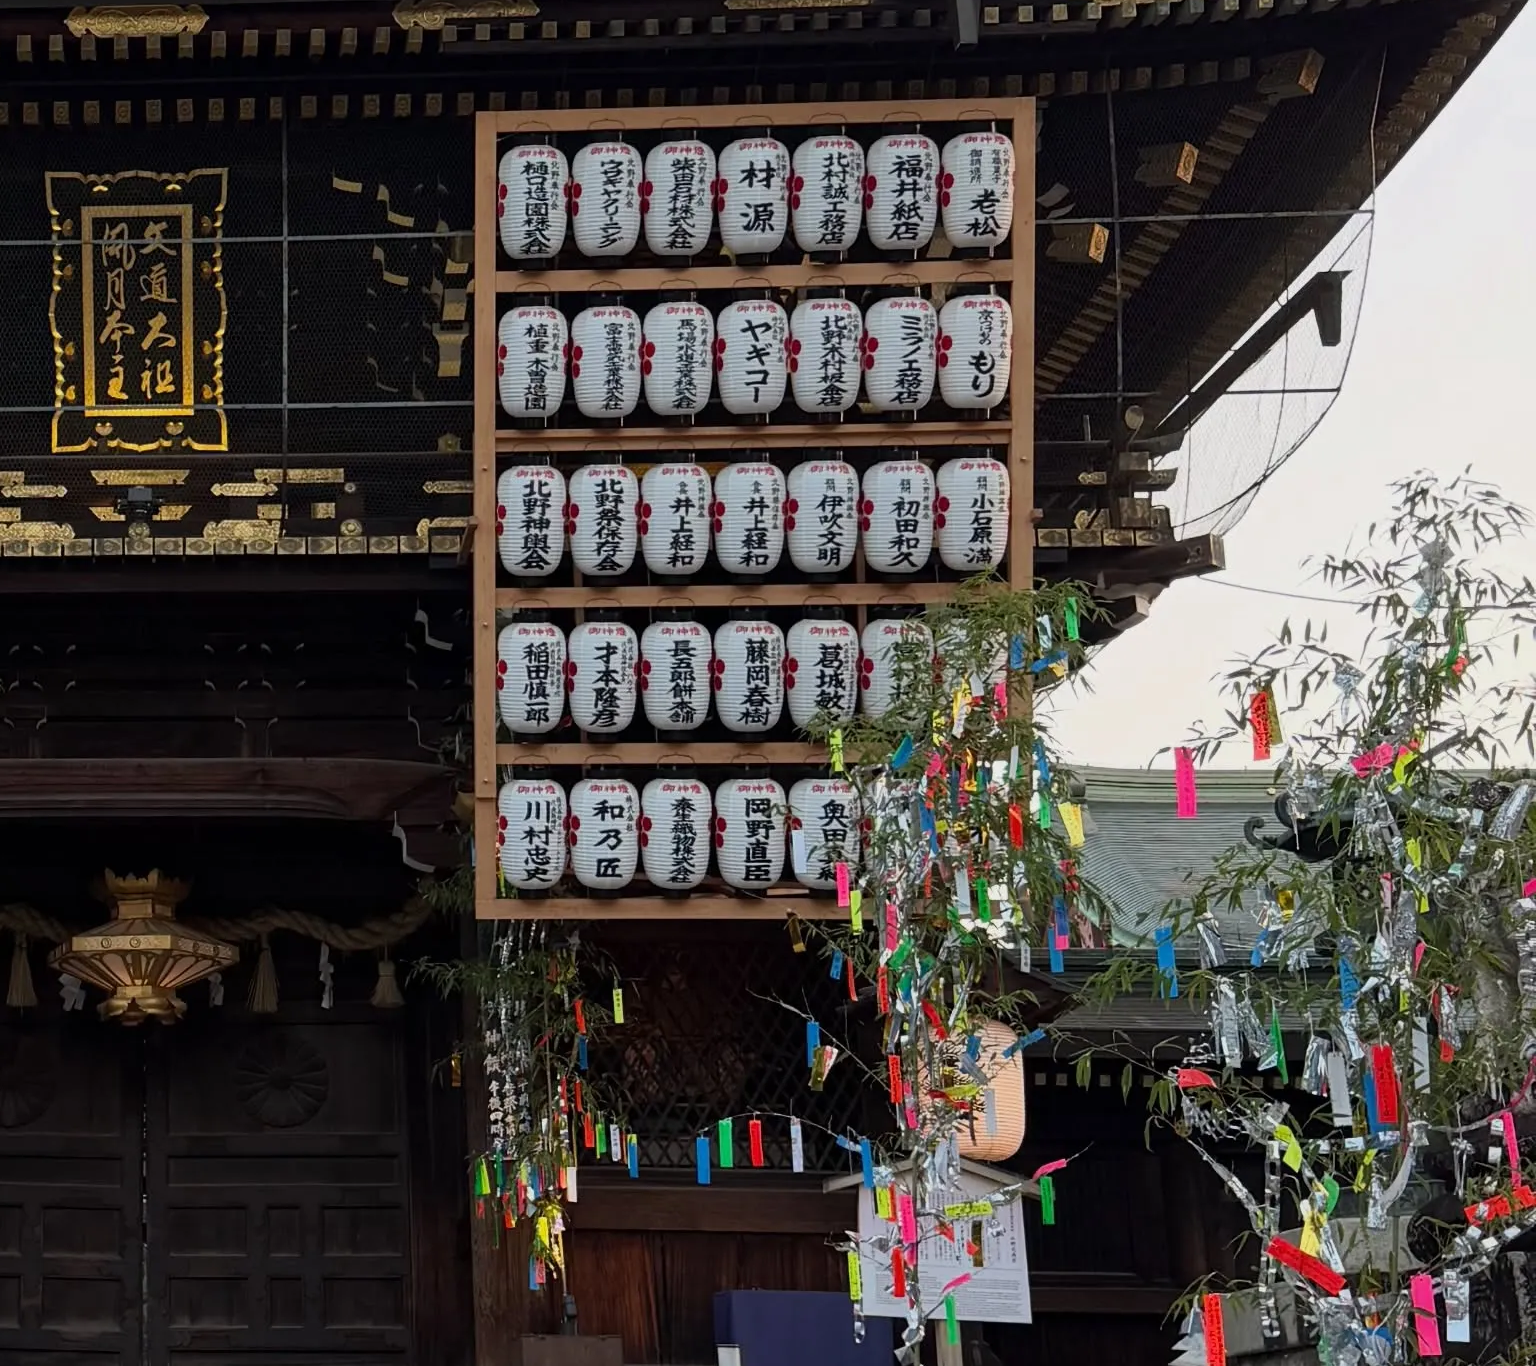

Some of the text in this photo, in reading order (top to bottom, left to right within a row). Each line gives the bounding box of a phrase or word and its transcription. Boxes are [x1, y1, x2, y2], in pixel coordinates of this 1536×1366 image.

[520, 161, 552, 256] 樋口造園株式会社
[598, 160, 624, 249] ウサギヤクリーニング
[665, 157, 697, 249] 柴田石材株式会社
[739, 160, 776, 233] 材源
[817, 152, 851, 245] 北村誠工務店
[887, 155, 924, 241] 福井紙店
[965, 189, 1002, 238] 老松
[740, 319, 772, 403] ヤギコー
[816, 315, 847, 407] 北野木村板金店
[889, 315, 924, 404] ミラノ工務店
[968, 351, 997, 398] もり
[592, 479, 625, 573] 北野祭保存会
[666, 498, 696, 568] 井上経和
[739, 496, 769, 567] 井上経和
[815, 494, 846, 567] 伊吹文明
[888, 497, 920, 568] 初田和久
[963, 494, 994, 564] 小石原満
[522, 641, 550, 727] 稲田慎一郎
[589, 642, 622, 728] 才本隆彦
[738, 637, 772, 726] 藤岡春樹
[520, 801, 553, 882] 川村忠史
[592, 800, 625, 879] 和乃匠
[744, 798, 775, 882] 岡野直臣
